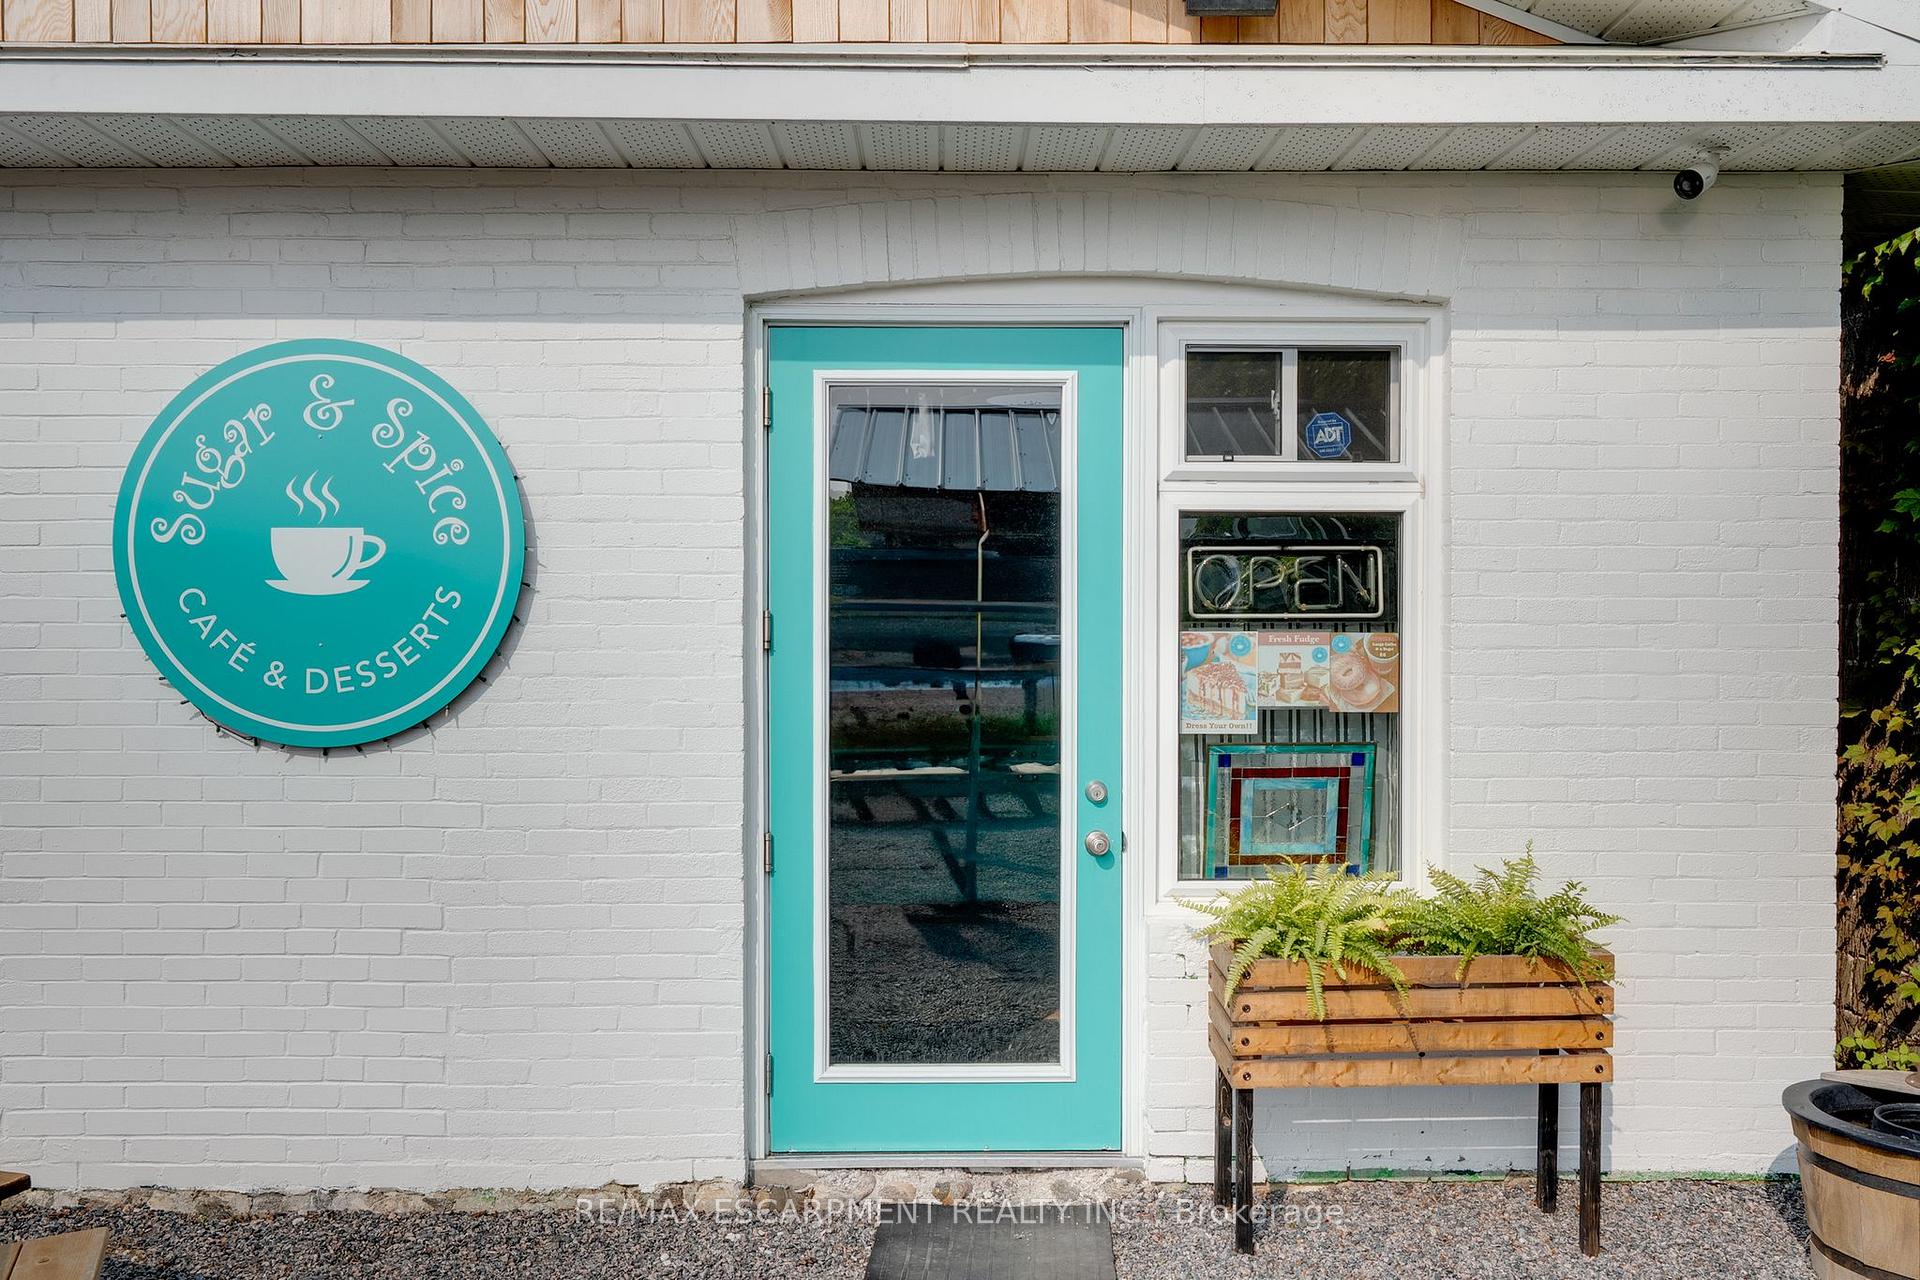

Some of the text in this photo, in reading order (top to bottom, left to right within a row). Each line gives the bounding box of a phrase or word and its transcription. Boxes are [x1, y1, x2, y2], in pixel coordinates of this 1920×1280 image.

[151, 373, 471, 545] Sugar & Spice
[1315, 426, 1344, 444] ADT
[1194, 553, 1376, 611] OPEN
[178, 585, 462, 695] CAFÉ & DESSERTS
[1268, 634, 1320, 645] Fresh Fudge
